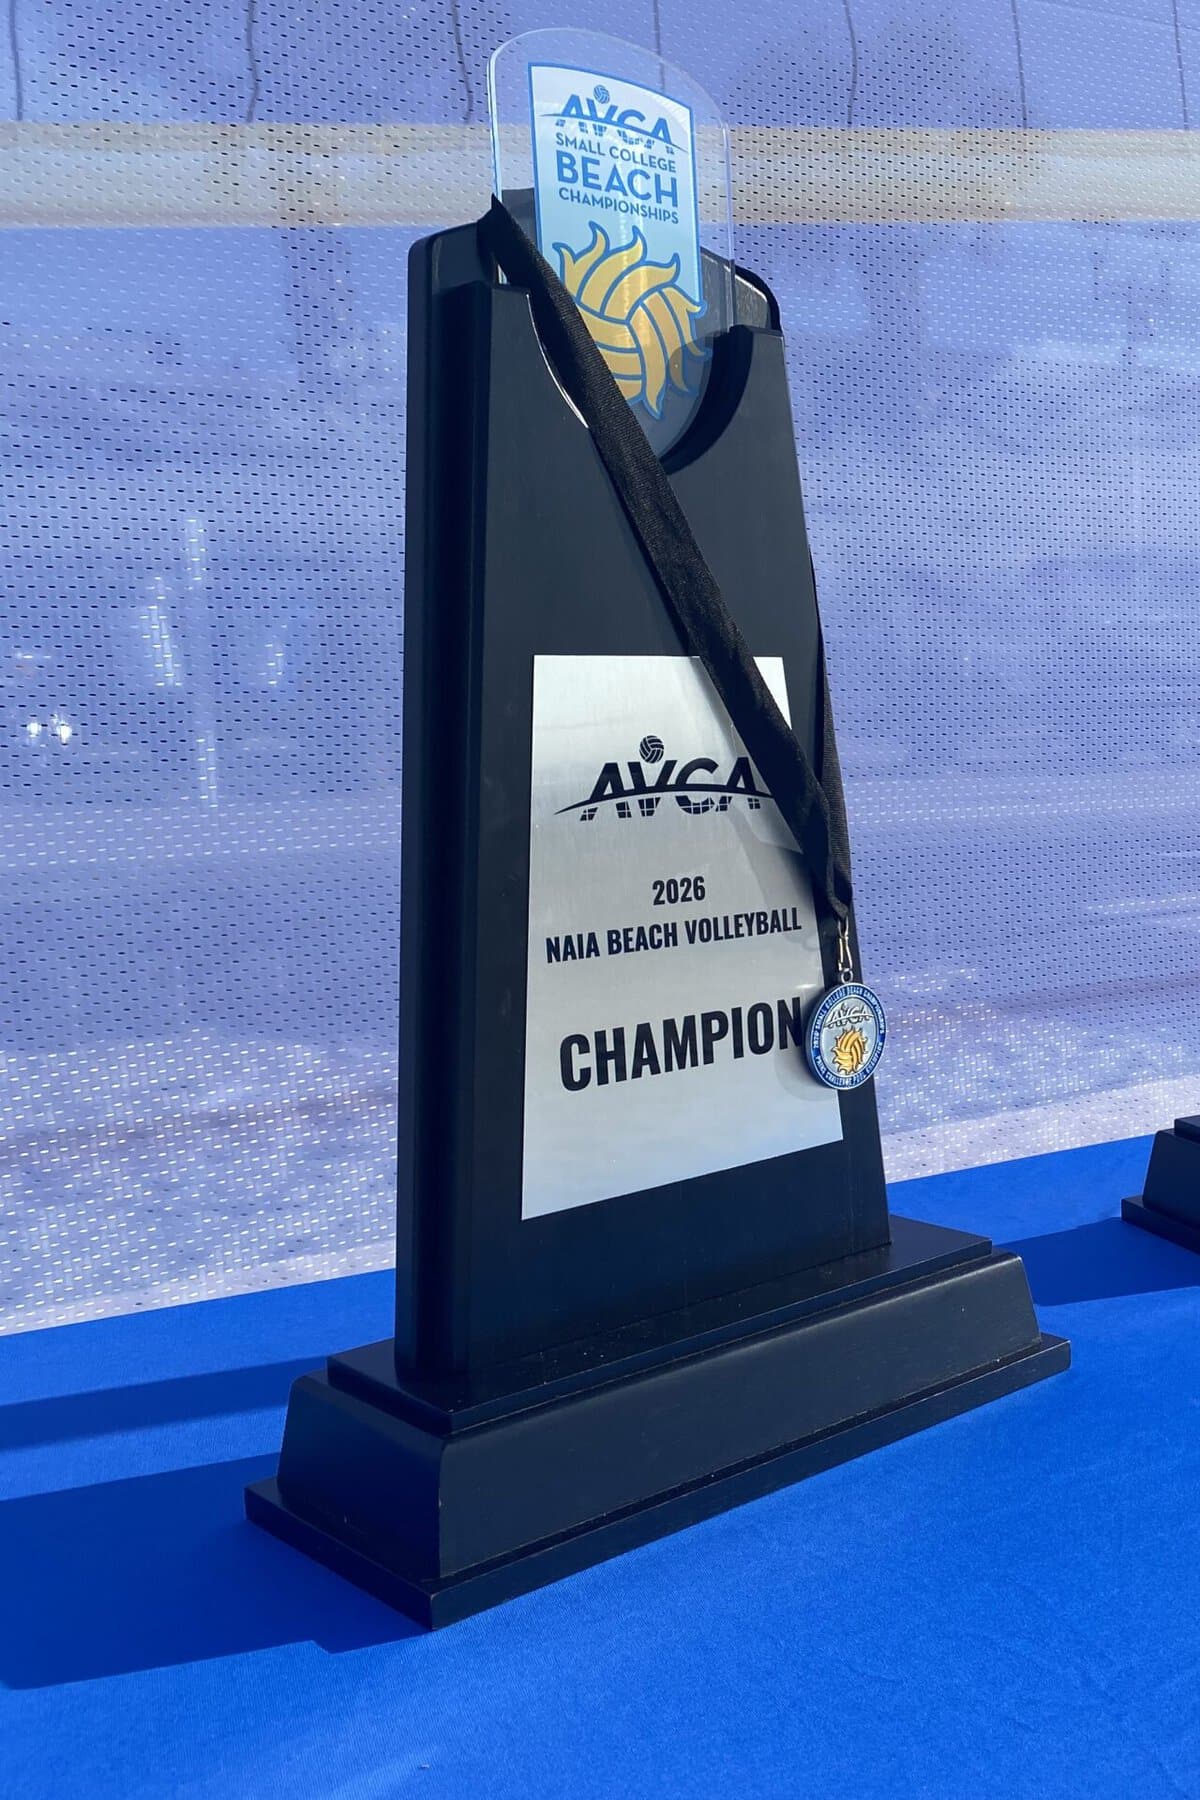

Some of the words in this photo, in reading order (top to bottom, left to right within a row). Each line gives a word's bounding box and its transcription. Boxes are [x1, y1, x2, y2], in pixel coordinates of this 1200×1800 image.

[555, 93, 676, 154] AVCA
[555, 132, 606, 156] SMALL
[609, 146, 677, 173] COLLEGE
[556, 149, 679, 208] BEACH
[558, 187, 679, 224] CHAMPIONSHIPS
[580, 756, 762, 822] AVCA
[652, 876, 706, 906] 2026
[545, 931, 600, 964] NAIA
[606, 921, 678, 956] BEACH
[685, 907, 803, 945] VOLLEYBALL
[559, 996, 801, 1092] CHAMPION
